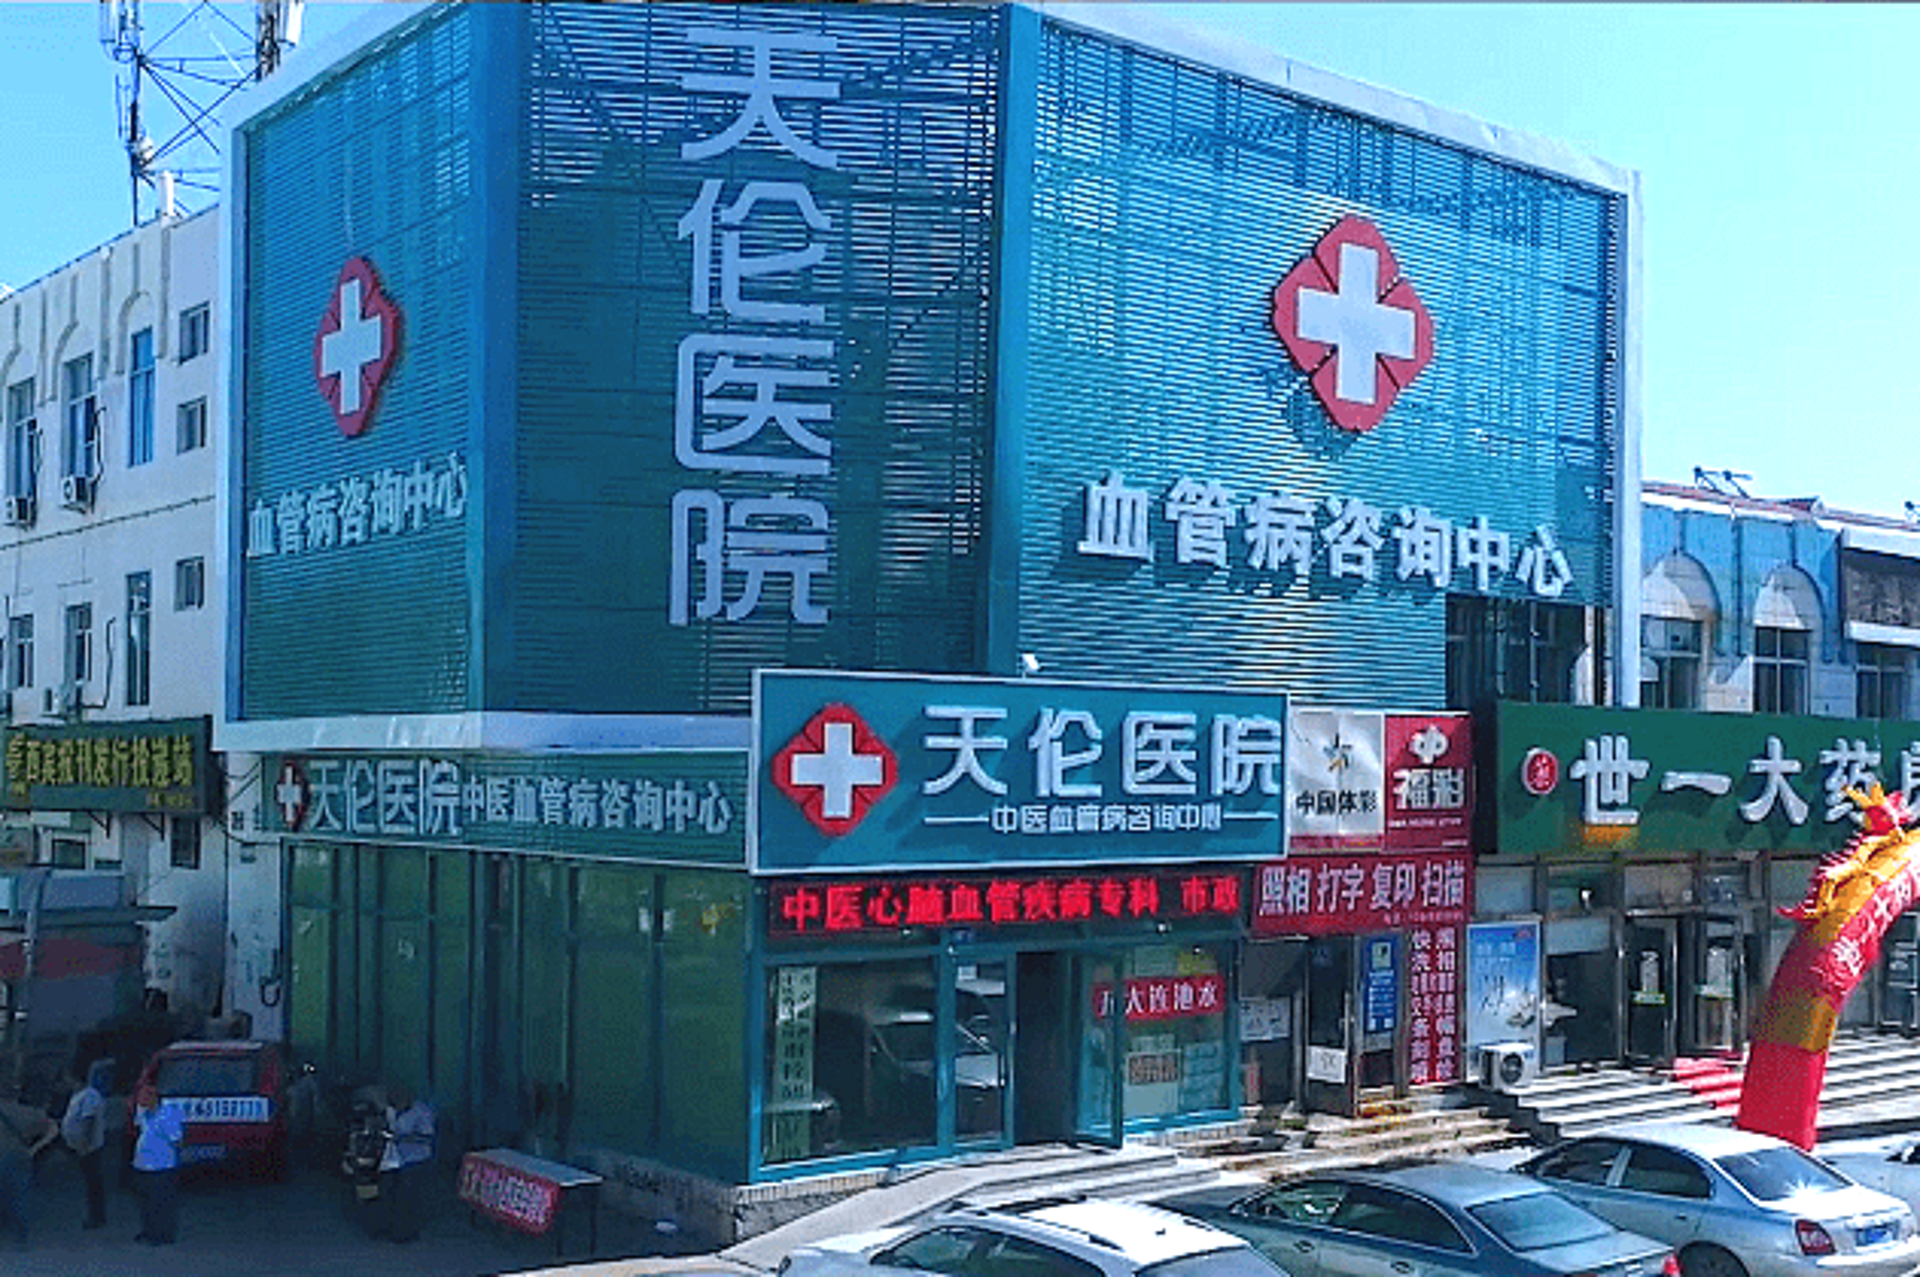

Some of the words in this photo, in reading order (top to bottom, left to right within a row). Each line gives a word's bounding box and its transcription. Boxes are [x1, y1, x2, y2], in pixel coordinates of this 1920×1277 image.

[670, 27, 840, 626] 天伦医院
[247, 450, 467, 557] 血管病咨询中心
[1078, 470, 1574, 598] 血管病咨询中心
[923, 704, 1282, 798] 天伦医院
[308, 758, 462, 837] 天伦医院
[463, 774, 732, 835] 中医血管病咨询中心
[991, 803, 1222, 834] 中医血管病咨询中心
[1295, 789, 1377, 815] 中国体彩
[1393, 768, 1465, 810] 福彩
[782, 876, 1160, 931] 中医心脑血管疾病专科
[1259, 866, 1313, 916] 照相
[1317, 862, 1365, 913] 打字
[1369, 862, 1417, 910] 复印
[1421, 859, 1466, 907] 扫描
